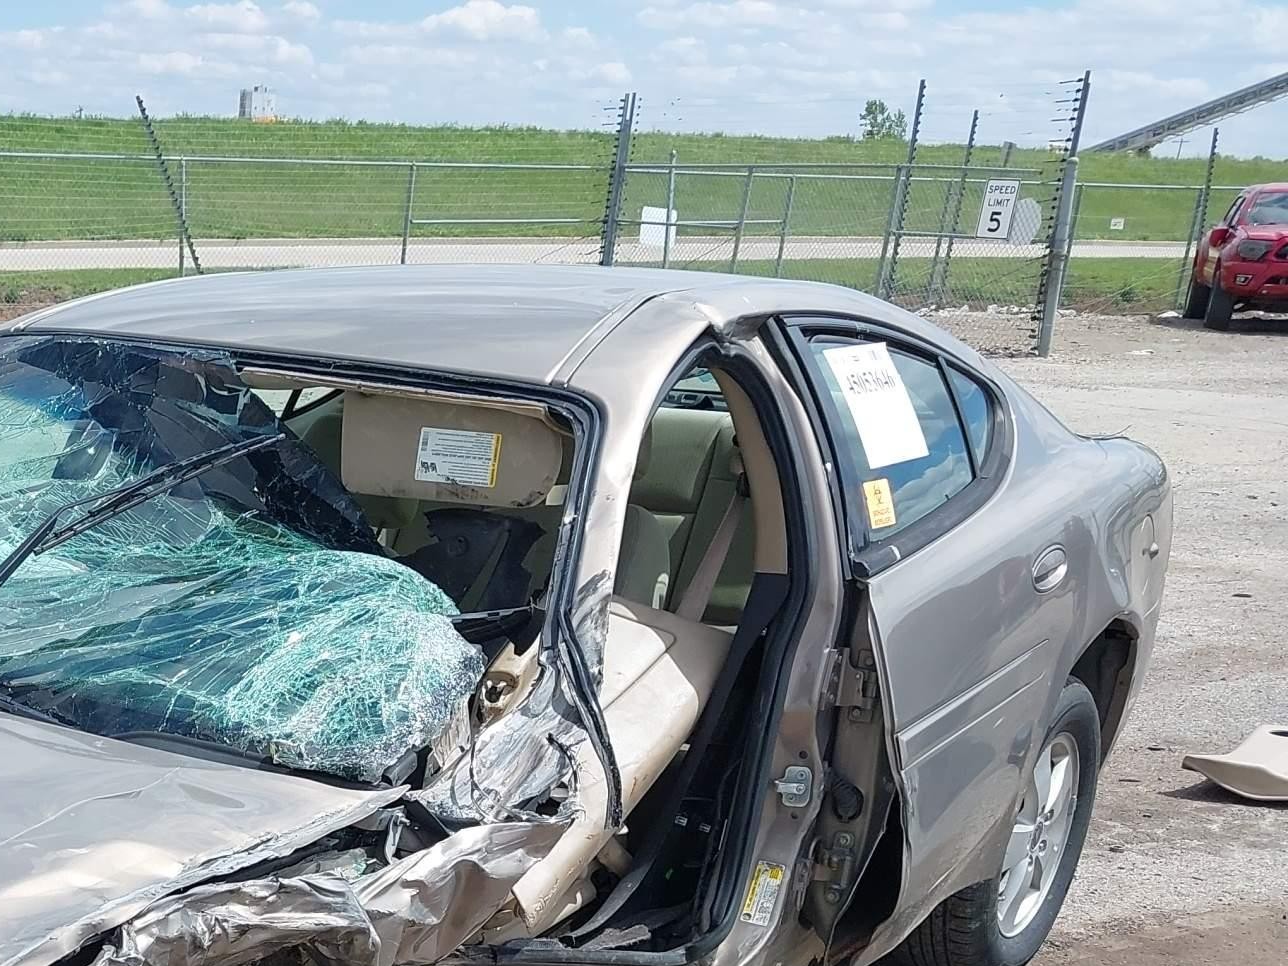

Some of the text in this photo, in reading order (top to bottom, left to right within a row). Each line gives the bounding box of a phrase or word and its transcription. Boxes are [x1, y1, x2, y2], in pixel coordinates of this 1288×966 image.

[988, 185, 1016, 194] SPEED
[988, 198, 1011, 207] LIMIT
[987, 211, 1002, 232] 5
